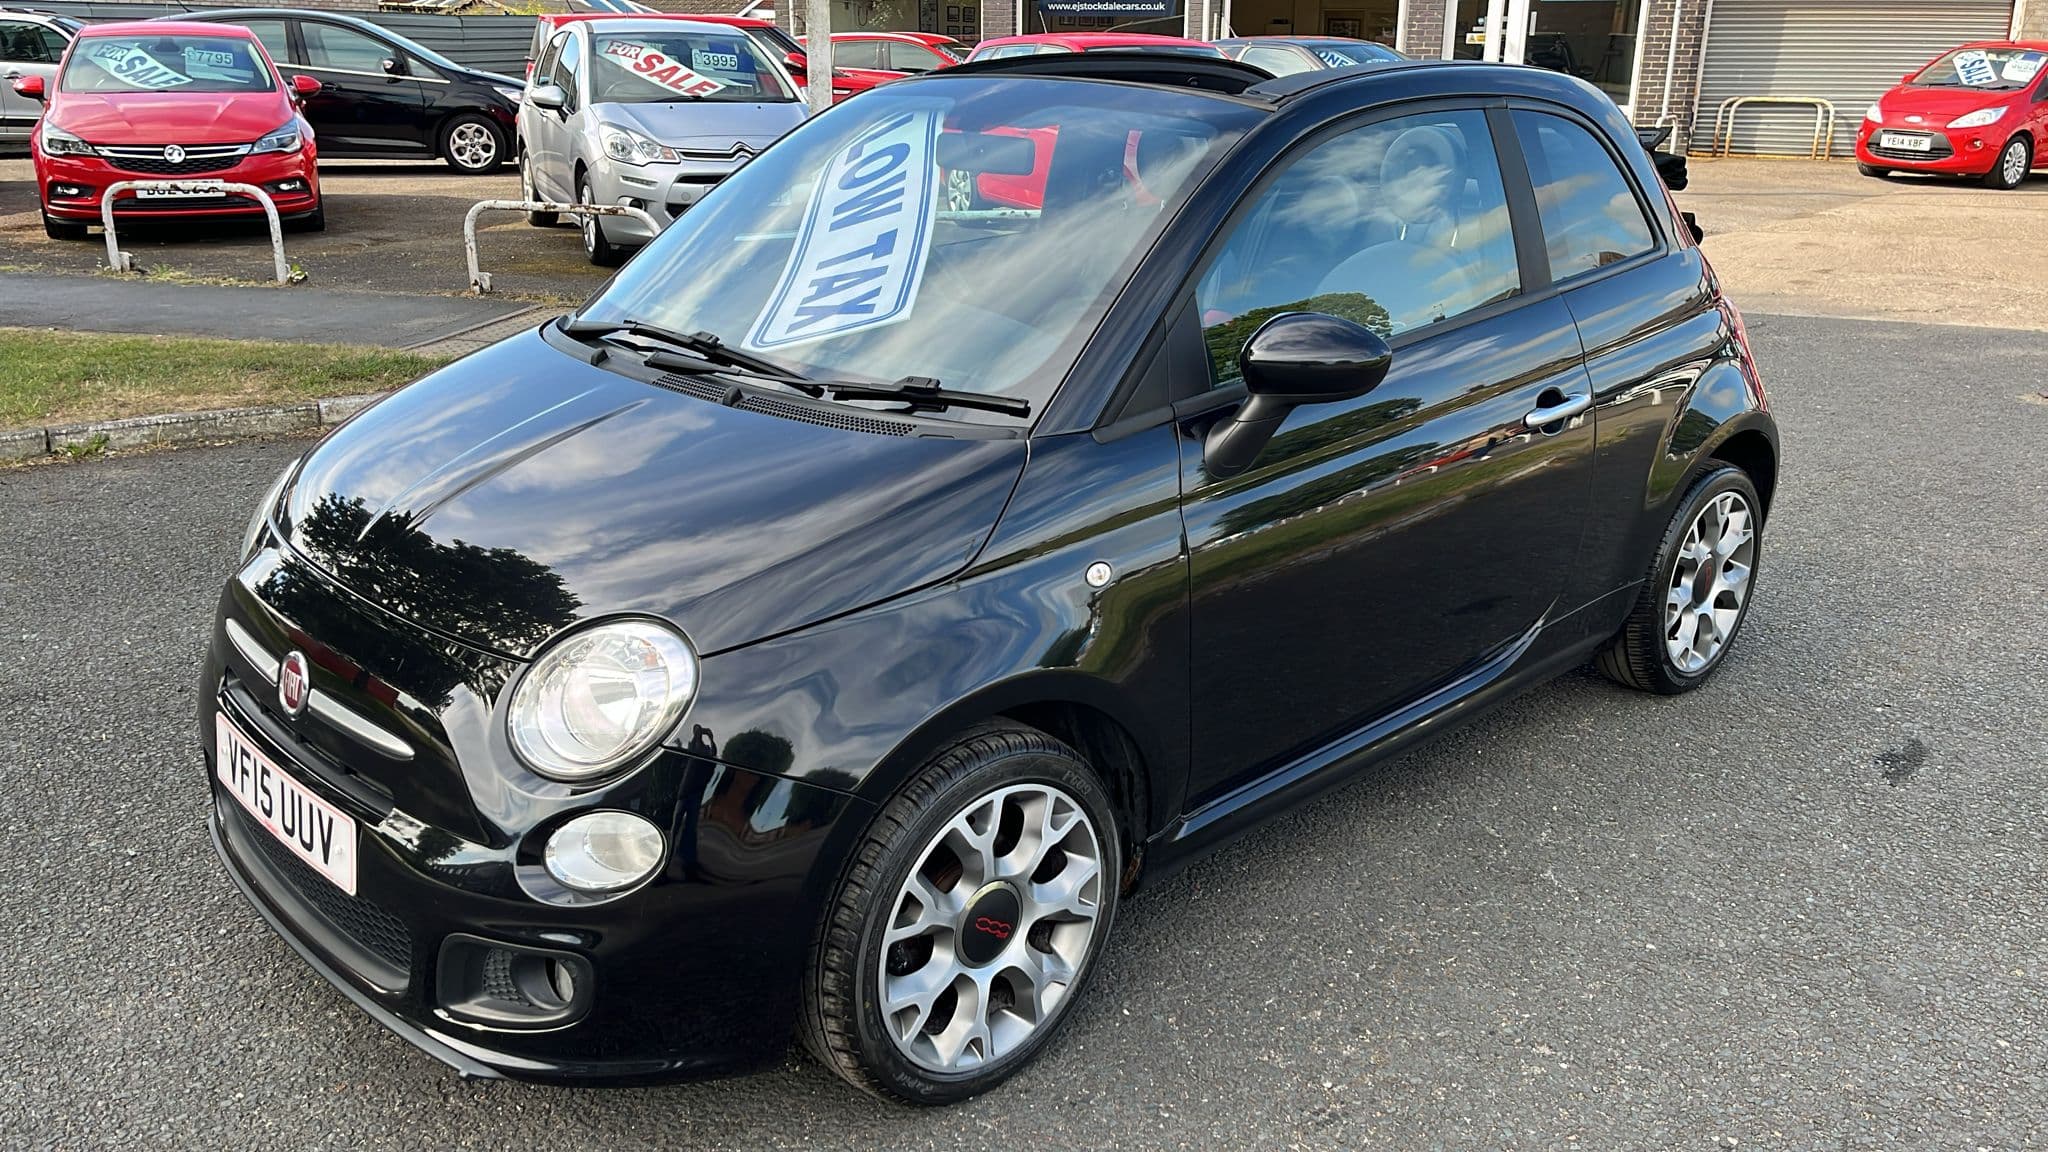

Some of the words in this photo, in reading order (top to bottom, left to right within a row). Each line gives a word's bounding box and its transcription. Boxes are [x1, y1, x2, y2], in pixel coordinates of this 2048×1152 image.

[1048, 1, 1166, 11] www.ejstockdalecars.co.uk
[97, 44, 126, 61] FOR
[114, 55, 183, 87] SALE
[607, 41, 643, 58] FOR
[633, 54, 719, 97] SALE
[1960, 59, 1992, 84] SALE
[829, 111, 915, 232] LOW
[786, 228, 899, 335] TAX
[285, 668, 300, 701] FIAT
[227, 733, 273, 819] VF15
[280, 780, 334, 866] UUV
